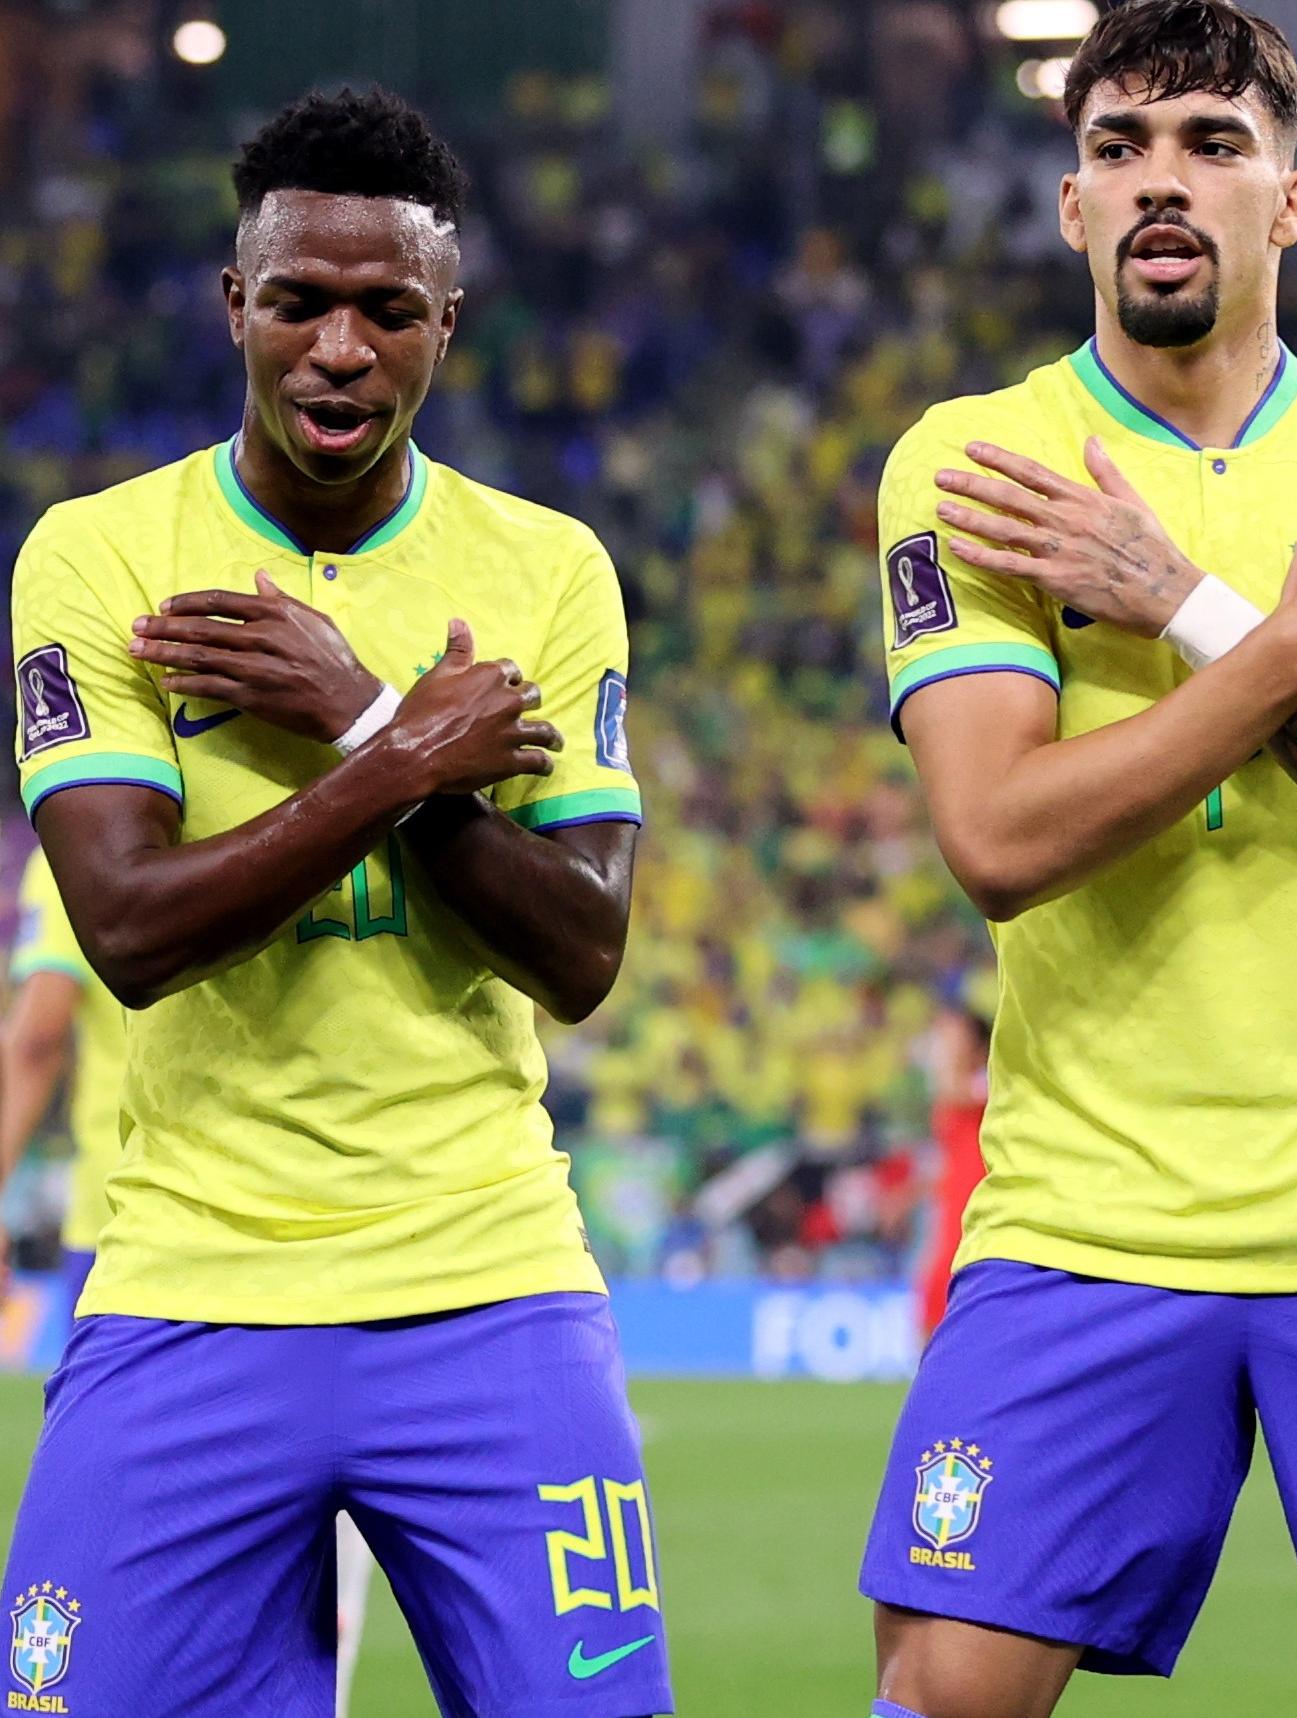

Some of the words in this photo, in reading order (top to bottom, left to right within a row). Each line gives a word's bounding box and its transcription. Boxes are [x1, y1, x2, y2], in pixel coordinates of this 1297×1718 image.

[934, 1491, 960, 1503] CBF
[536, 1474, 661, 1617] 20
[909, 1546, 976, 1571] BRASIL
[29, 1636, 52, 1648] CBF
[7, 1691, 69, 1714] BRASIL
